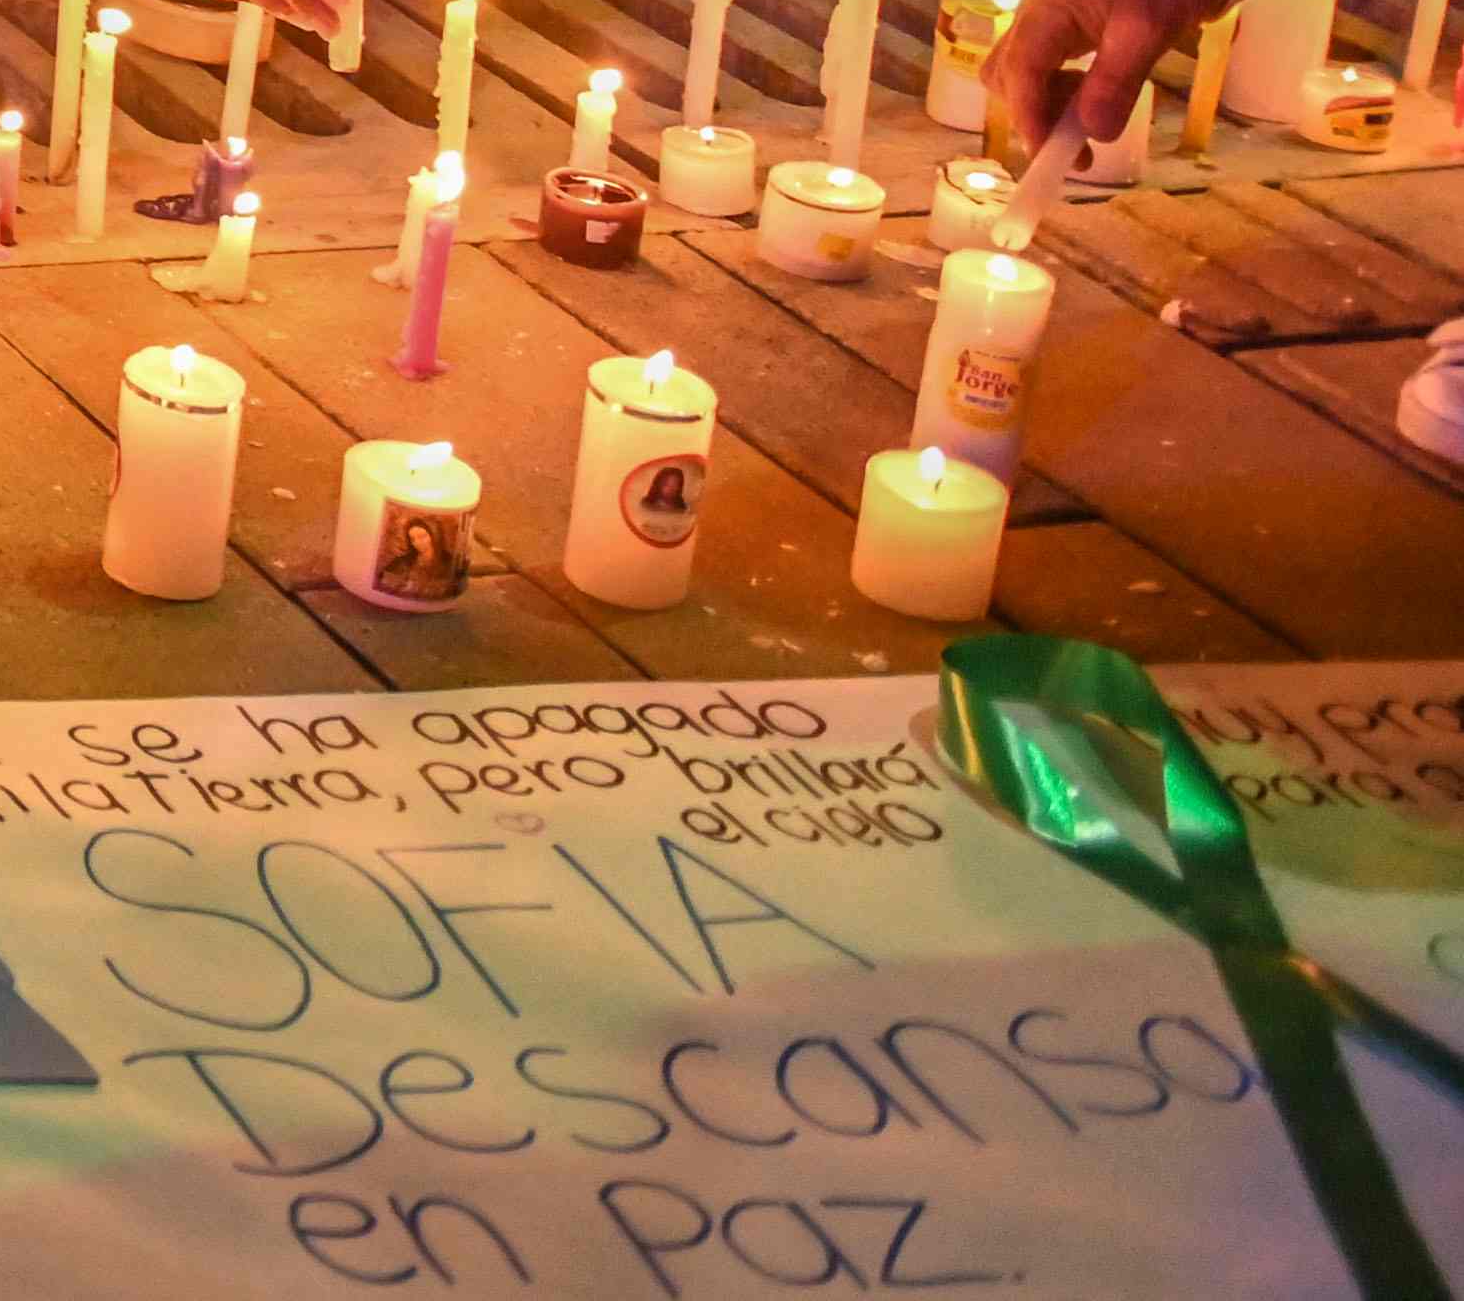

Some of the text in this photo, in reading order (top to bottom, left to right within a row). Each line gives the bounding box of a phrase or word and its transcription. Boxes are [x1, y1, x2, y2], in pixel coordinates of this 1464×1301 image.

[67, 723, 203, 765] se
[236, 704, 378, 755] ha
[411, 689, 827, 759] apagado
[417, 755, 625, 815] pero
[659, 742, 941, 799] brillará
[83, 827, 877, 1033] SOFIA
[287, 1190, 535, 1287] en
